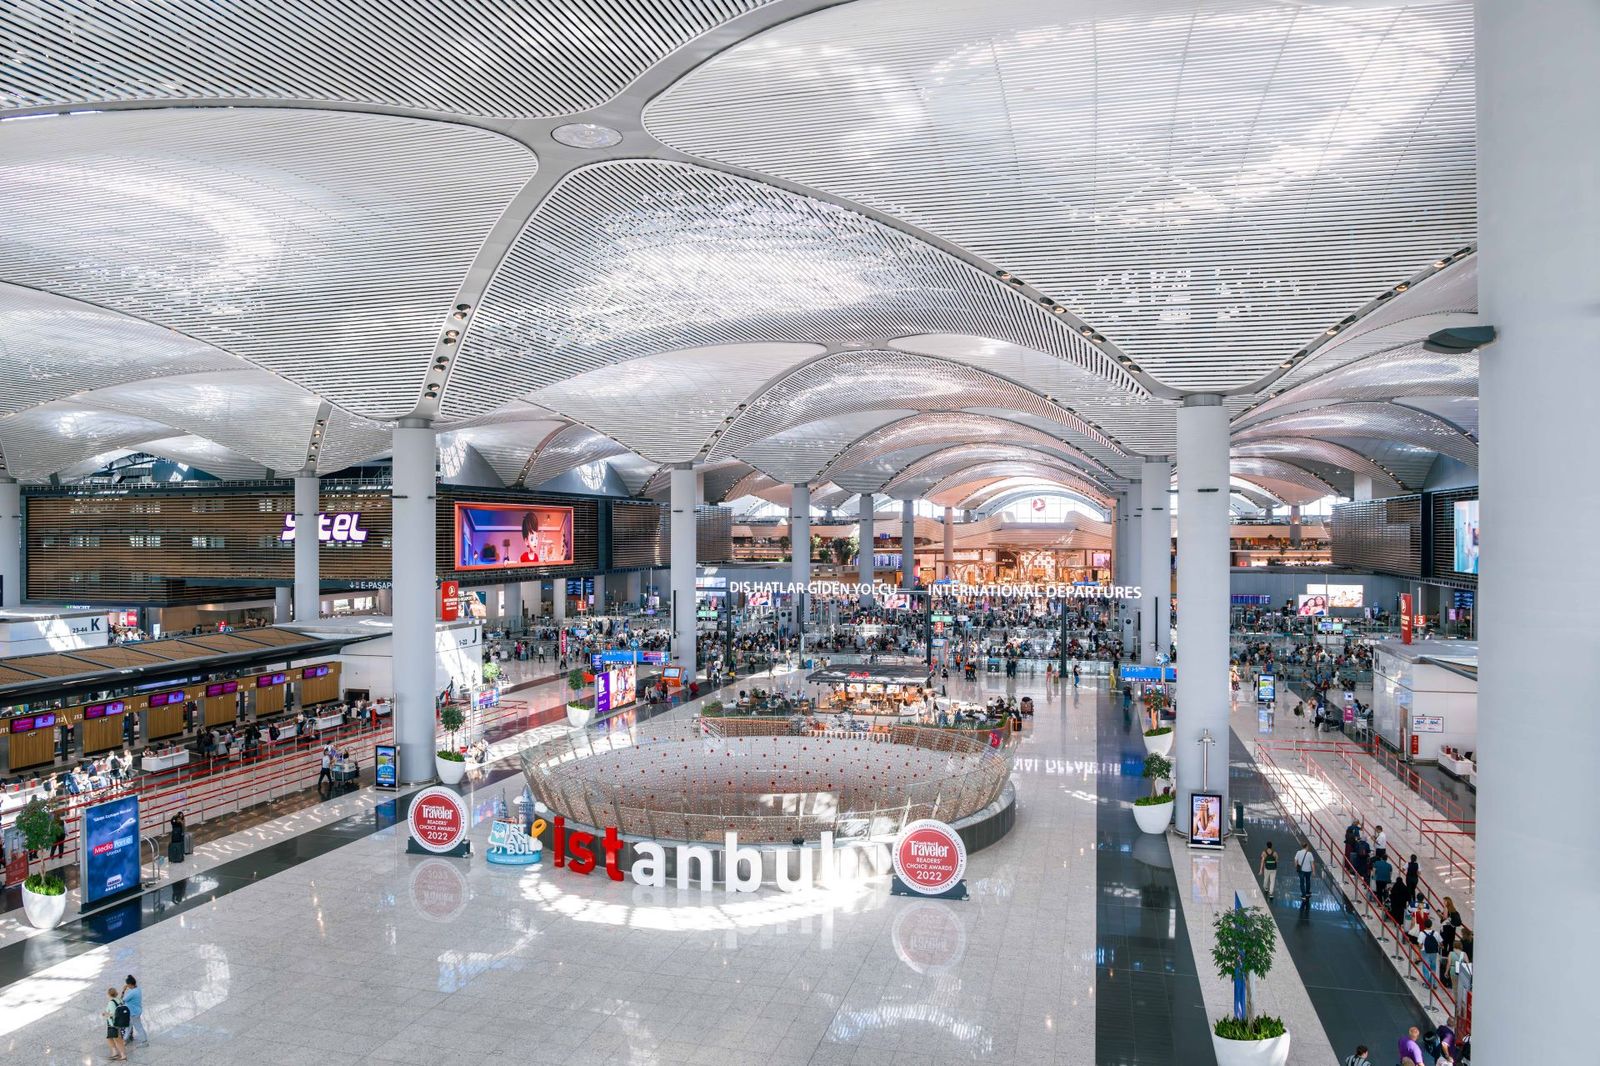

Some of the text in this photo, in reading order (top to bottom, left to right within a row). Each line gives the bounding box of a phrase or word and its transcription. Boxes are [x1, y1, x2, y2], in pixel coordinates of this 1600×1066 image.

[360, 581, 393, 590] E-PASAP
[729, 581, 751, 596] DIŞ
[754, 581, 805, 594] HATLAR
[853, 583, 898, 596] YOLCU
[927, 584, 1142, 599] INTERNATIONAL DEPARTURES
[91, 617, 101, 632] K
[472, 628, 478, 644] J
[421, 804, 454, 820] Traveler
[427, 832, 448, 841] 2022
[507, 842, 533, 856] BUL
[909, 840, 950, 858] Traveler
[916, 870, 942, 881] 2022
